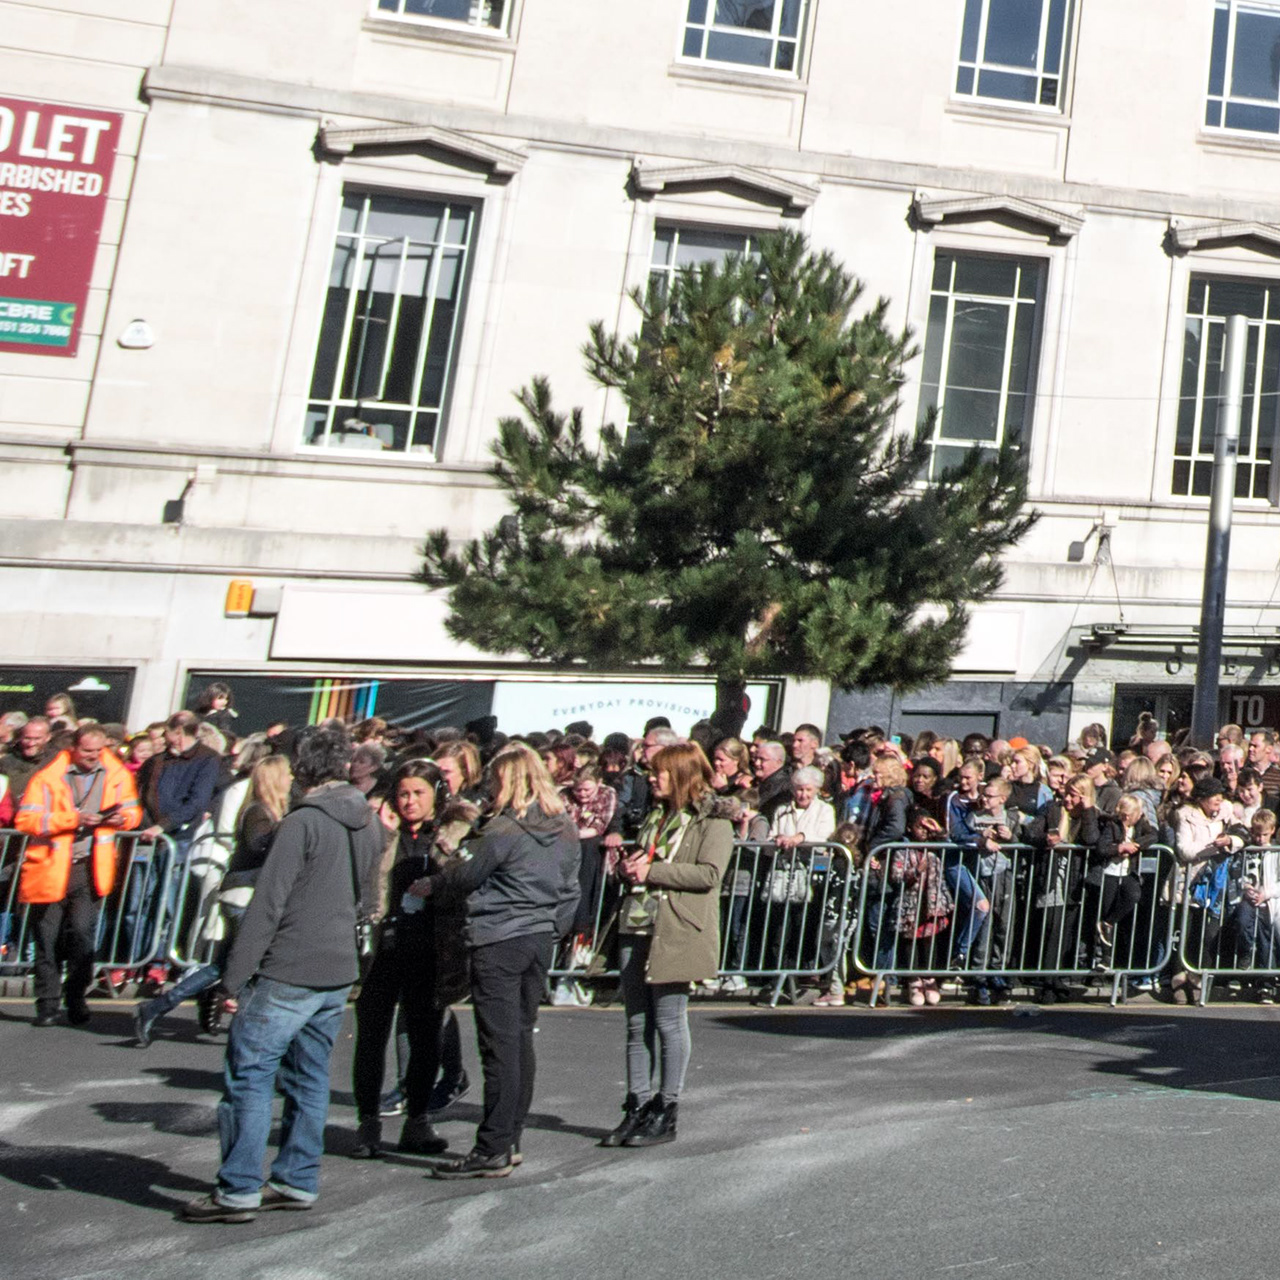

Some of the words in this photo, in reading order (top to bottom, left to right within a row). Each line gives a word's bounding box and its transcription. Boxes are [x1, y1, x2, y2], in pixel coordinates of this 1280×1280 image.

[19, 110, 111, 165] LET
[1165, 656, 1238, 676] OE
[552, 700, 621, 717] EVERYDAY
[629, 698, 709, 718] PROVISIONS
[1232, 695, 1265, 725] TO
